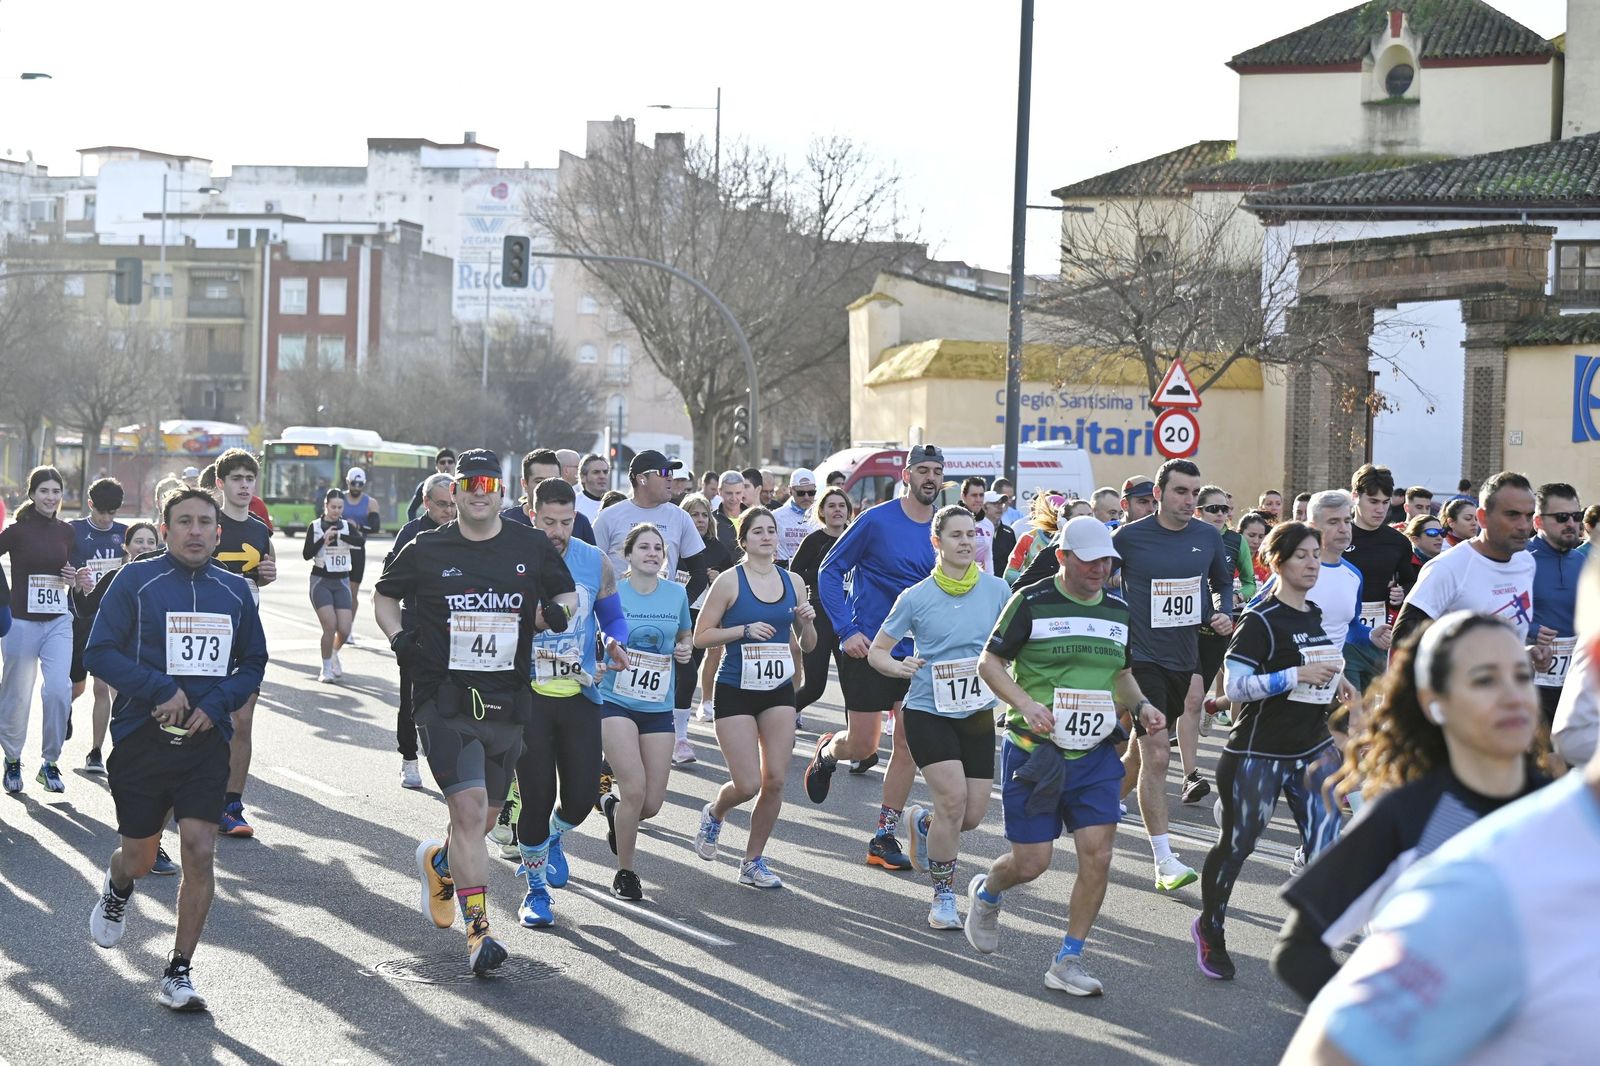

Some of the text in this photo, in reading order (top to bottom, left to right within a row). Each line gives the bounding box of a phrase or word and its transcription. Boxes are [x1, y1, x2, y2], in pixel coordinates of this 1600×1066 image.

[1059, 391, 1133, 411] Santísima
[1165, 427, 1189, 443] 20
[331, 556, 347, 566] 160
[37, 589, 61, 605] 594
[1162, 595, 1194, 617] 490
[170, 616, 193, 634] XLII
[181, 635, 220, 662] 373
[471, 634, 497, 658] 44
[1052, 644, 1093, 655] ATLETISMO
[754, 660, 784, 680] 140
[934, 663, 954, 680] XLII
[1547, 655, 1573, 675] 27
[628, 668, 661, 691] 146
[947, 676, 982, 700] 174
[1056, 692, 1080, 711] XLII
[1065, 712, 1104, 736] 452
